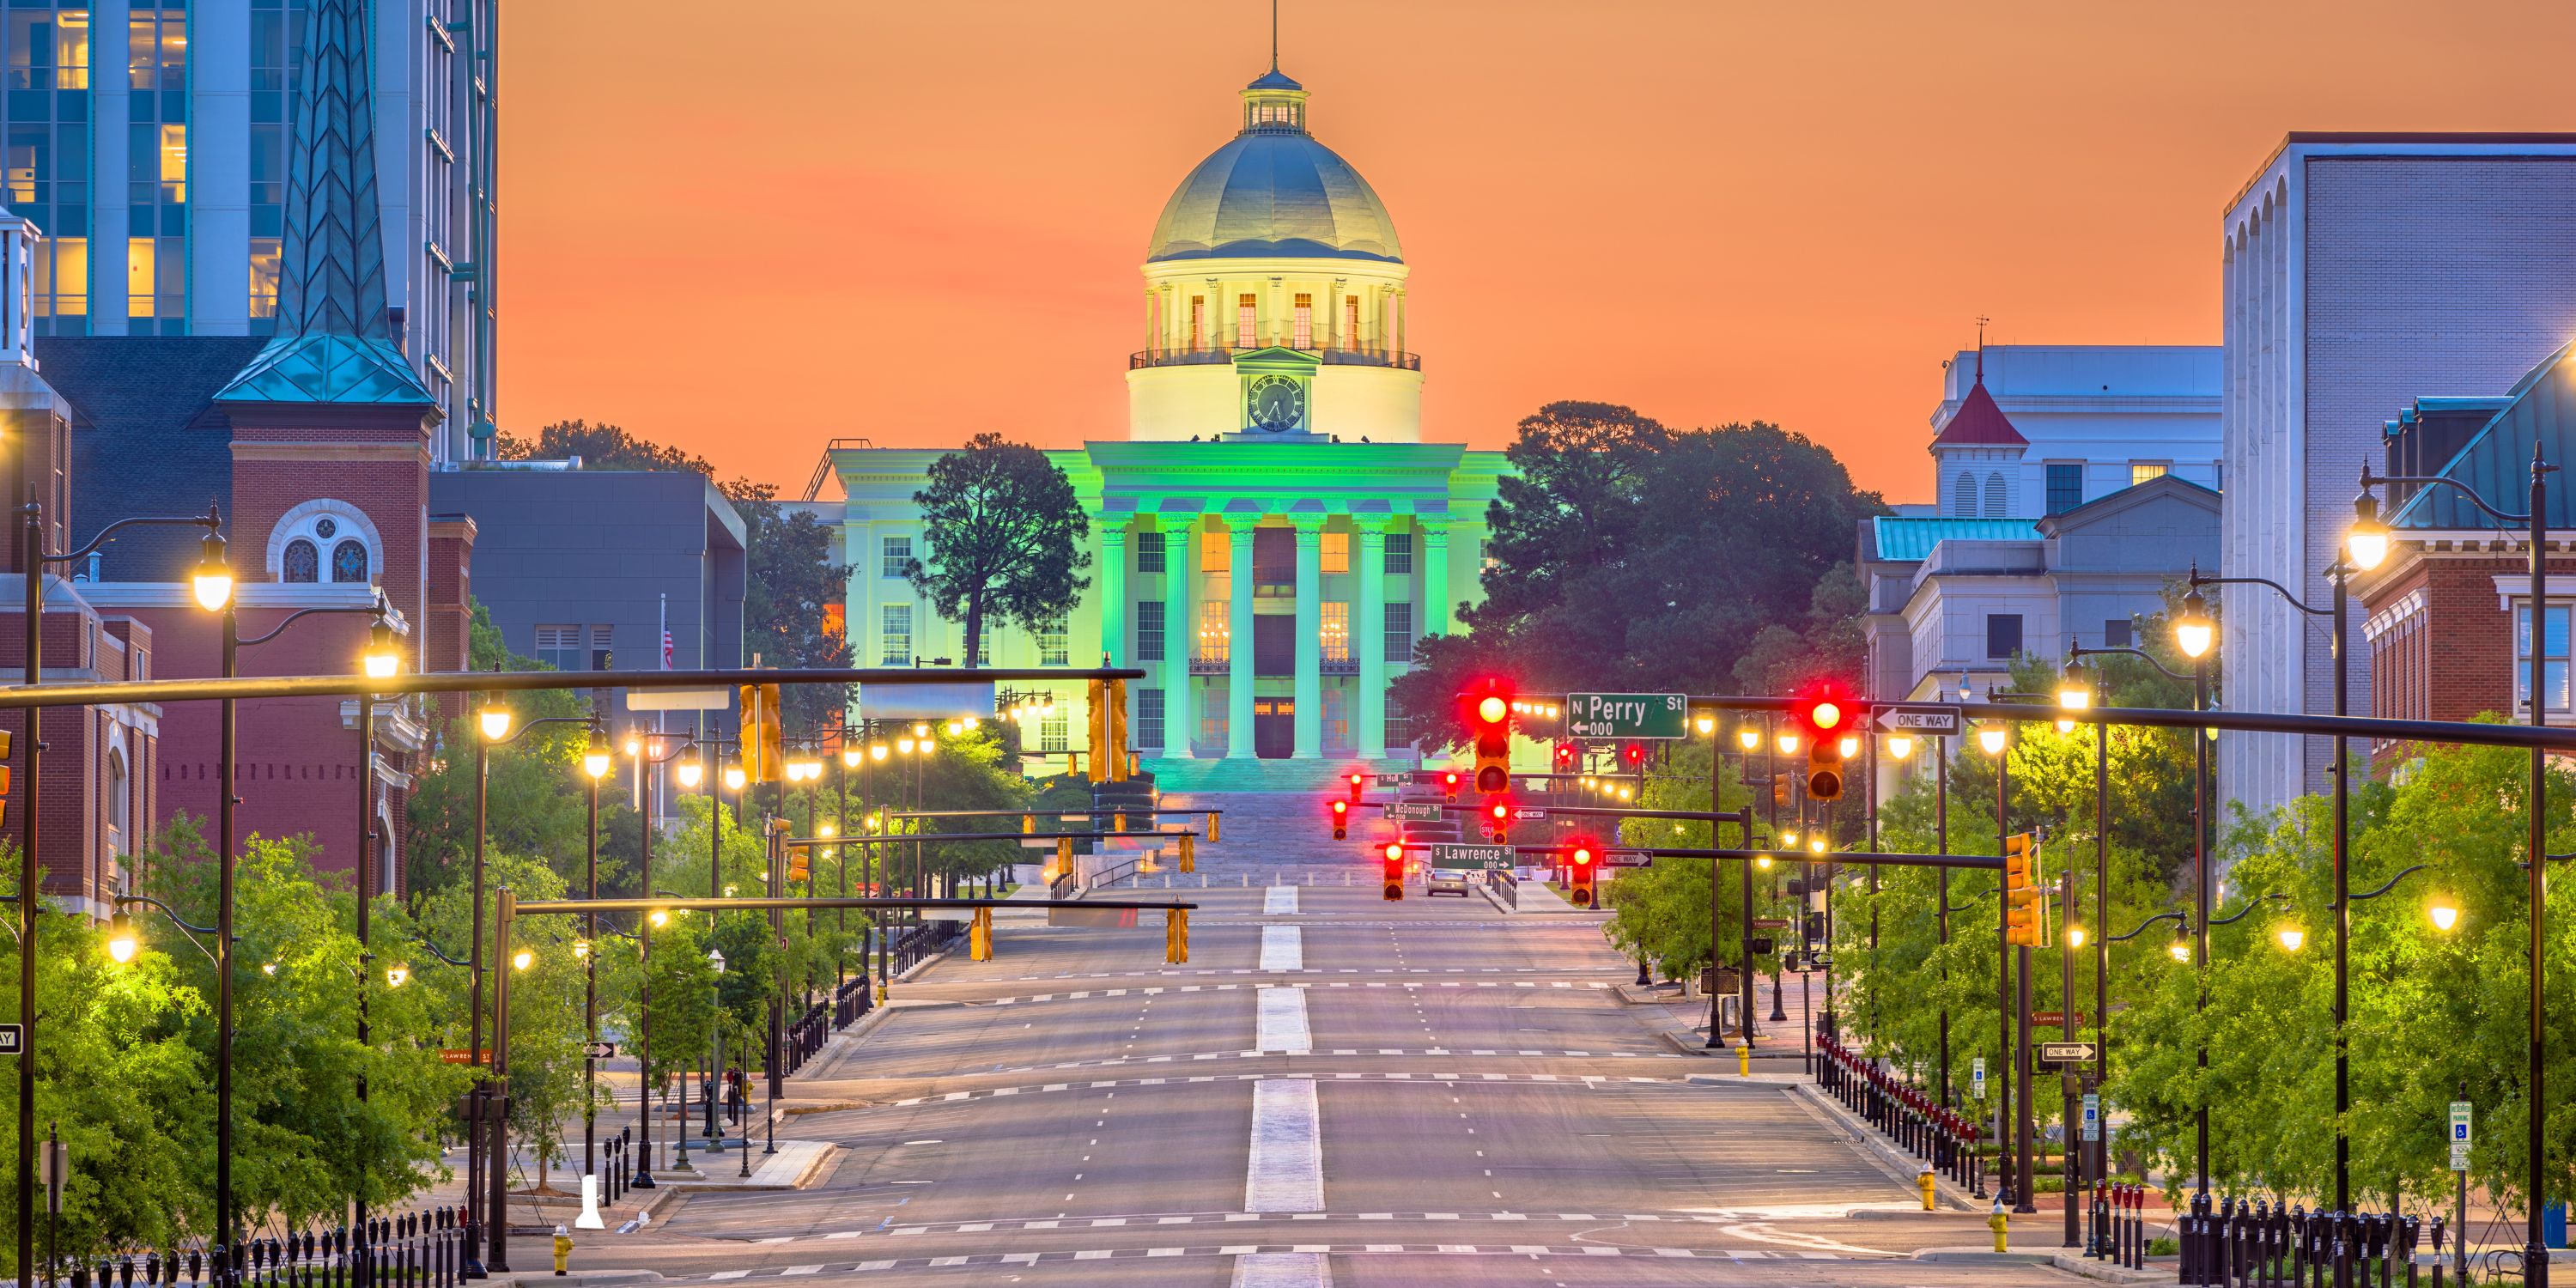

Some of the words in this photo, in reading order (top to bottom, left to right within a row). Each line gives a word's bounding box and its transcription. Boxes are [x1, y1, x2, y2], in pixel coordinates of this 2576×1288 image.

[1572, 701, 1583, 714] N
[1589, 696, 1646, 726] Perry
[1667, 696, 1682, 711] St
[1898, 715, 1922, 726] ONE
[1925, 715, 1951, 726] WAY
[1589, 722, 1613, 736] 000
[1395, 804, 1431, 817] McDonough
[1436, 848, 1440, 856] S
[1445, 846, 1500, 860] Lawrence
[1504, 847, 1512, 855] St
[1484, 860, 1498, 869] 000
